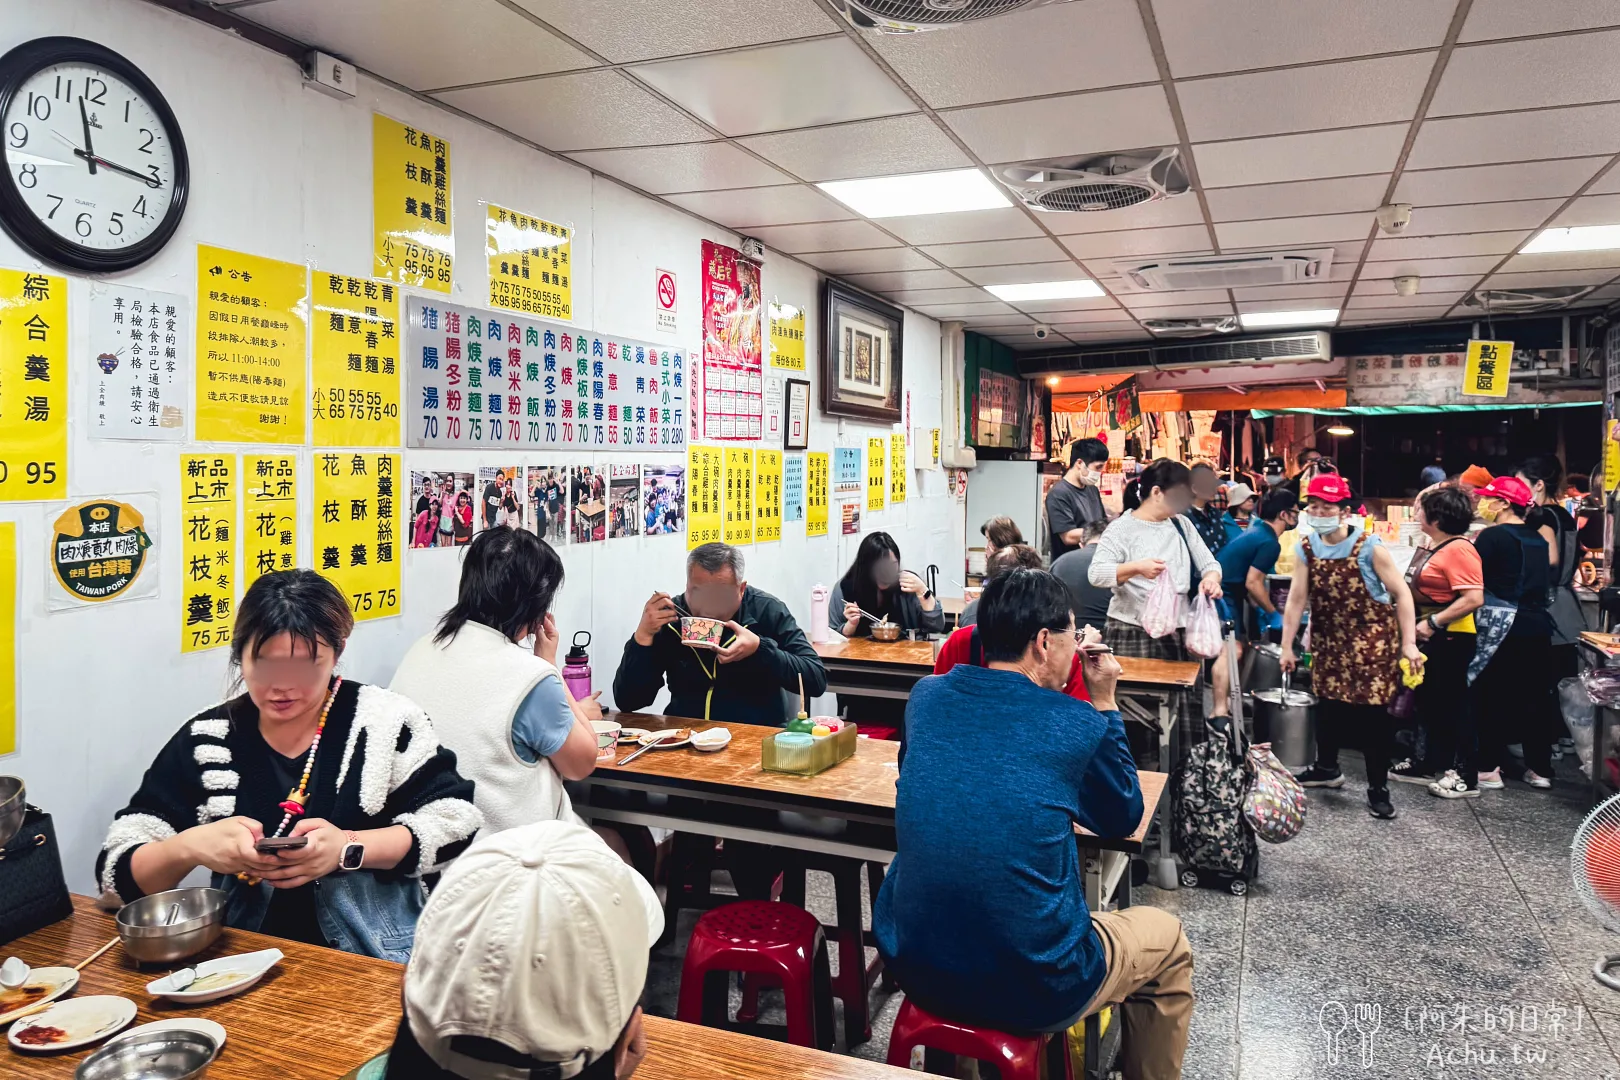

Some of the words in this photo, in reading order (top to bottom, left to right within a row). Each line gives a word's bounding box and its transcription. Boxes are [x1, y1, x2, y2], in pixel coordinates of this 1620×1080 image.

[56, 75, 72, 103] 11
[84, 76, 108, 106] 12
[28, 92, 51, 121] 10
[125, 100, 130, 123] 1
[10, 122, 28, 148] 9
[138, 128, 154, 154] 2
[18, 162, 38, 189] 8
[146, 164, 161, 189] 3
[404, 126, 418, 217] 花枝羹
[419, 132, 433, 222] 魚酥羹
[434, 139, 448, 226] 肉羹雞絲麵
[46, 194, 64, 220] 7
[74, 198, 96, 209] QUARTZ
[132, 195, 148, 218] 4
[75, 212, 92, 237] 6
[108, 212, 124, 236] 5
[382, 236, 394, 252] 小
[404, 242, 419, 258] 75
[421, 246, 435, 263] 75
[438, 252, 451, 268] 75
[228, 268, 253, 284] 公告
[382, 251, 394, 268] 大
[404, 259, 418, 275] 95
[421, 262, 434, 279] 95
[438, 268, 450, 283] 95
[329, 274, 345, 332] 乾麵
[490, 278, 499, 290] 小
[500, 281, 510, 294] 75
[511, 284, 520, 296] 75
[522, 286, 532, 298] 75
[532, 290, 542, 300] 50
[542, 292, 552, 303] 55
[552, 294, 561, 304] 55
[113, 296, 126, 335] 享用。
[490, 292, 499, 304] 大
[500, 294, 510, 306] 95
[511, 297, 520, 309] 95
[522, 300, 532, 312] 95
[532, 302, 542, 314] 65
[542, 304, 552, 316] 75
[552, 306, 562, 318] 75
[561, 304, 570, 314] 40
[346, 276, 363, 372] 乾意麵
[380, 284, 396, 375] 青菜湯
[23, 272, 50, 422] 綜合羹湯
[207, 350, 229, 362] 所以
[232, 353, 280, 368] 11:00-14:00
[130, 300, 144, 426] 局檢驗合格，請安心
[148, 302, 161, 428] 本店食品已通過衛生
[1476, 344, 1498, 391] 點餐區
[608, 342, 618, 422] 乾意麵
[622, 344, 632, 422] 乾麵
[207, 391, 290, 406] 造成不便敬請見諒
[312, 386, 326, 404] 小
[330, 388, 345, 403] 50
[348, 390, 364, 404] 55
[366, 391, 382, 406] 55
[312, 404, 326, 420] 大
[330, 403, 345, 419] 65
[349, 404, 365, 420] 75
[366, 406, 382, 422] 75
[382, 402, 398, 418] 40
[423, 416, 438, 440] 70
[446, 416, 461, 440] 70
[468, 418, 482, 441] 75
[490, 418, 502, 441] 70
[508, 420, 521, 442] 70
[528, 422, 540, 442] 70
[546, 422, 556, 442] 70
[562, 422, 573, 442] 70
[578, 424, 588, 443] 70
[594, 426, 604, 444] 75
[608, 426, 618, 444] 55
[623, 428, 633, 445] 50
[636, 426, 645, 444] 35
[649, 428, 658, 444] 35
[662, 428, 670, 445] 30
[672, 428, 684, 444] 280
[26, 462, 56, 484] 95
[187, 458, 228, 478] 新品
[256, 459, 293, 478] 新品
[188, 479, 229, 500] 上市
[256, 478, 294, 498] 上市
[322, 454, 341, 570] 花枝羹
[350, 454, 368, 567] 魚酥羹
[376, 454, 393, 564] 肉羹雞絲麵
[88, 521, 111, 534] 本店
[88, 558, 132, 579] 台灣豬
[186, 514, 214, 626] 花枝羹
[75, 582, 106, 596] TAIWAN
[106, 576, 128, 593] PORK
[353, 592, 373, 613] 75
[378, 588, 396, 609] 75
